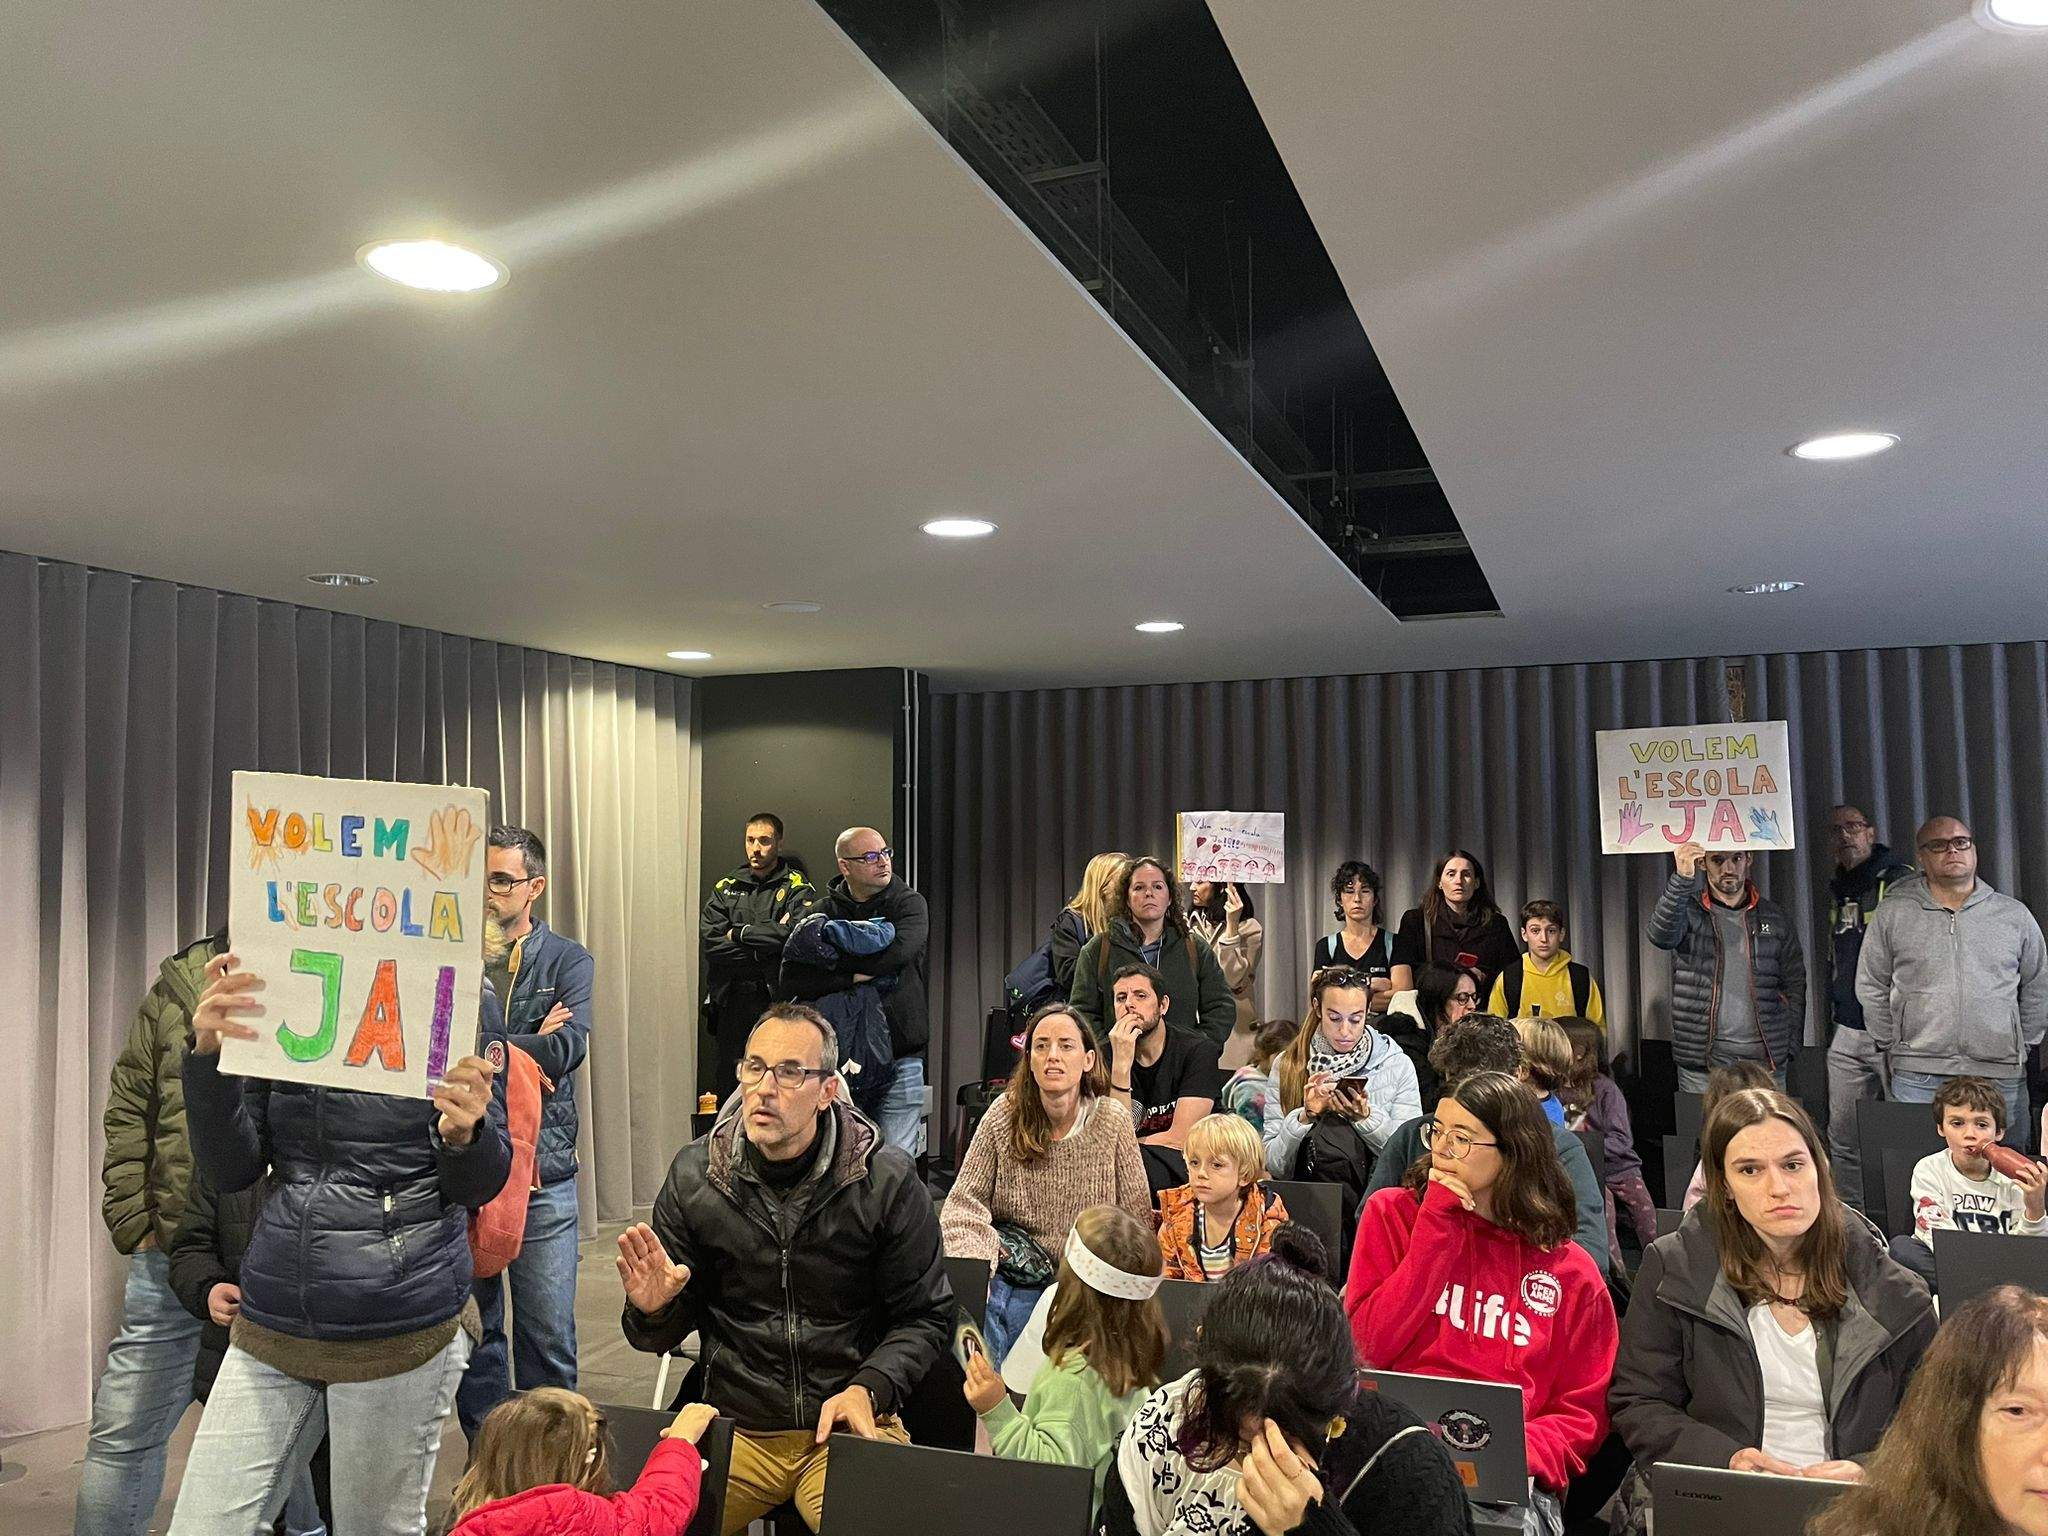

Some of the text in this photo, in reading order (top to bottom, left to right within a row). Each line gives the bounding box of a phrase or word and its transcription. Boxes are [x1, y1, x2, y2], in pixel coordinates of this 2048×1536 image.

[1629, 734, 1758, 763] VOLEM
[1618, 765, 1778, 800] L'ESCOLA
[247, 808, 410, 861] VOLEM
[1661, 799, 1746, 844] JA
[266, 881, 464, 942] L'ESCOLA
[1952, 1194, 1996, 1212] PAW
[1530, 1290, 1554, 1305] ARMS
[1531, 1282, 1556, 1297] OPEN
[1674, 1488, 1722, 1501] Lenovo
